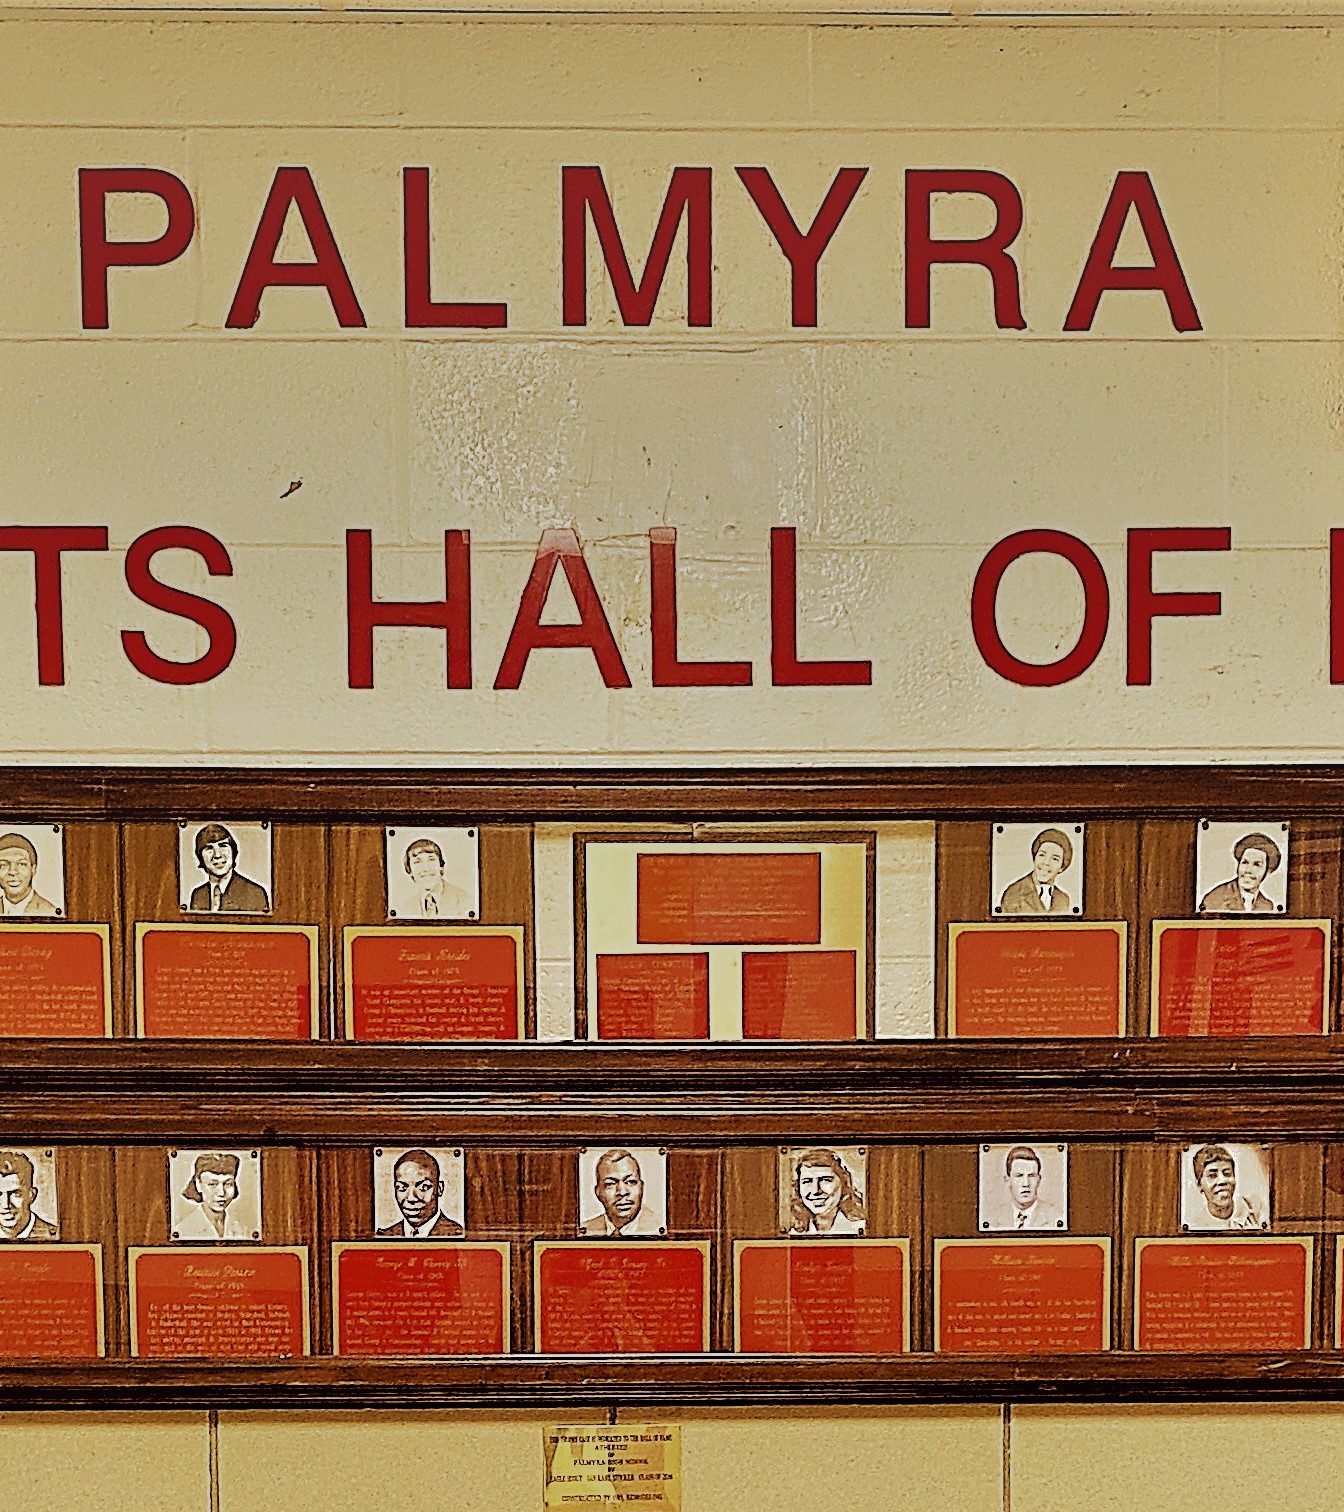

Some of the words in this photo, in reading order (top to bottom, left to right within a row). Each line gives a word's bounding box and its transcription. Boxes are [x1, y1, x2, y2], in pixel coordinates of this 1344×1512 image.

[81, 169, 1199, 329] PALMYRA
[348, 530, 870, 688] HALL
[973, 530, 1228, 686] OF
